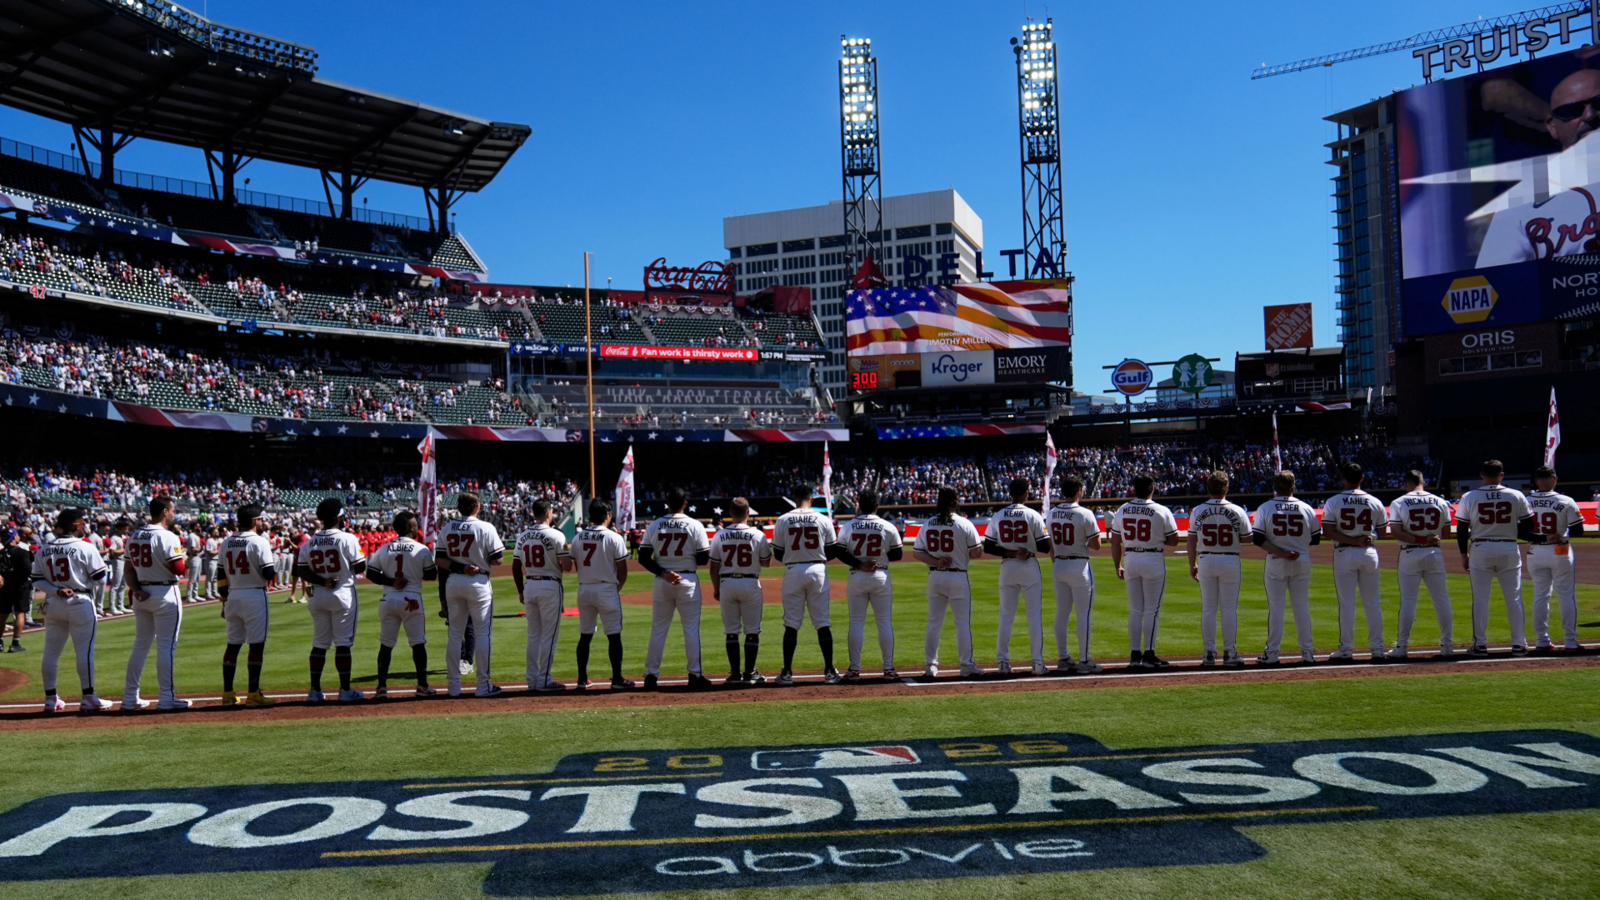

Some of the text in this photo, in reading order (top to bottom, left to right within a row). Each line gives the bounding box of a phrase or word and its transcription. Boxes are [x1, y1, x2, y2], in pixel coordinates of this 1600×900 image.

[1412, 8, 1579, 78] TRUIST
[643, 257, 737, 293] Coca-Cola
[903, 247, 1059, 281] DELTA
[29, 285, 46, 299] 47
[1552, 272, 1600, 289] NOR
[1575, 286, 1600, 298] HO
[1451, 287, 1490, 312] NAPA
[1265, 303, 1312, 349] HOME
[1270, 309, 1289, 328] THE
[925, 336, 991, 346] TIMOTHY MILLER
[1284, 319, 1312, 348] DEPOT
[1462, 330, 1515, 348] ORIS
[641, 348, 658, 356] Fan
[658, 348, 681, 356] work
[683, 348, 690, 356] is
[692, 349, 720, 359] thirsty
[997, 355, 1047, 369] EMORY
[932, 354, 983, 382] Kroger
[1114, 371, 1149, 384] Gulf
[1280, 362, 1315, 371] CLUBHOUSE
[852, 372, 877, 385] 300
[607, 388, 791, 404] HANK AARON TERRACE
[1275, 503, 1299, 512] ELDER
[1342, 497, 1369, 506] MAHLE
[1404, 498, 1438, 507] HICKLEN
[1486, 492, 1502, 500] LEE
[1530, 500, 1565, 512] IRSEY JR
[1004, 510, 1023, 518] KERR
[1052, 510, 1075, 520] RITCHIE
[1123, 507, 1155, 517] MEDEROS
[1195, 507, 1240, 533] SCHWELLENBACH
[1340, 508, 1372, 531] 54
[1409, 508, 1441, 531] 53
[1478, 501, 1512, 525] 52
[133, 532, 154, 540] OLSON
[451, 523, 472, 531] RILEY
[591, 533, 605, 541] KIM
[720, 531, 754, 542] HANDLEY
[851, 522, 884, 532] FUENTES
[999, 520, 1028, 543] 62
[1051, 522, 1074, 546] 60
[1122, 518, 1152, 541] 58
[1202, 524, 1233, 547] 56
[1272, 514, 1303, 537] 55
[309, 539, 334, 548] HARRIS
[386, 544, 414, 553] ALBIES
[446, 534, 475, 557] 27
[517, 532, 554, 551] YASTRZEMSKI
[658, 533, 688, 556] 77
[788, 527, 819, 550] 75
[852, 533, 882, 556] 72
[926, 529, 954, 552] 66
[129, 543, 153, 567] 28
[226, 551, 250, 575] 14
[309, 549, 341, 573] 23
[395, 554, 403, 578] 1
[522, 545, 545, 568] 18
[583, 543, 597, 566] 7
[722, 544, 752, 567] 76
[46, 558, 70, 582] 13
[594, 739, 1069, 773] 20 26
[0, 742, 1600, 858] POSTSEASON
[655, 838, 1095, 876] abbvie
